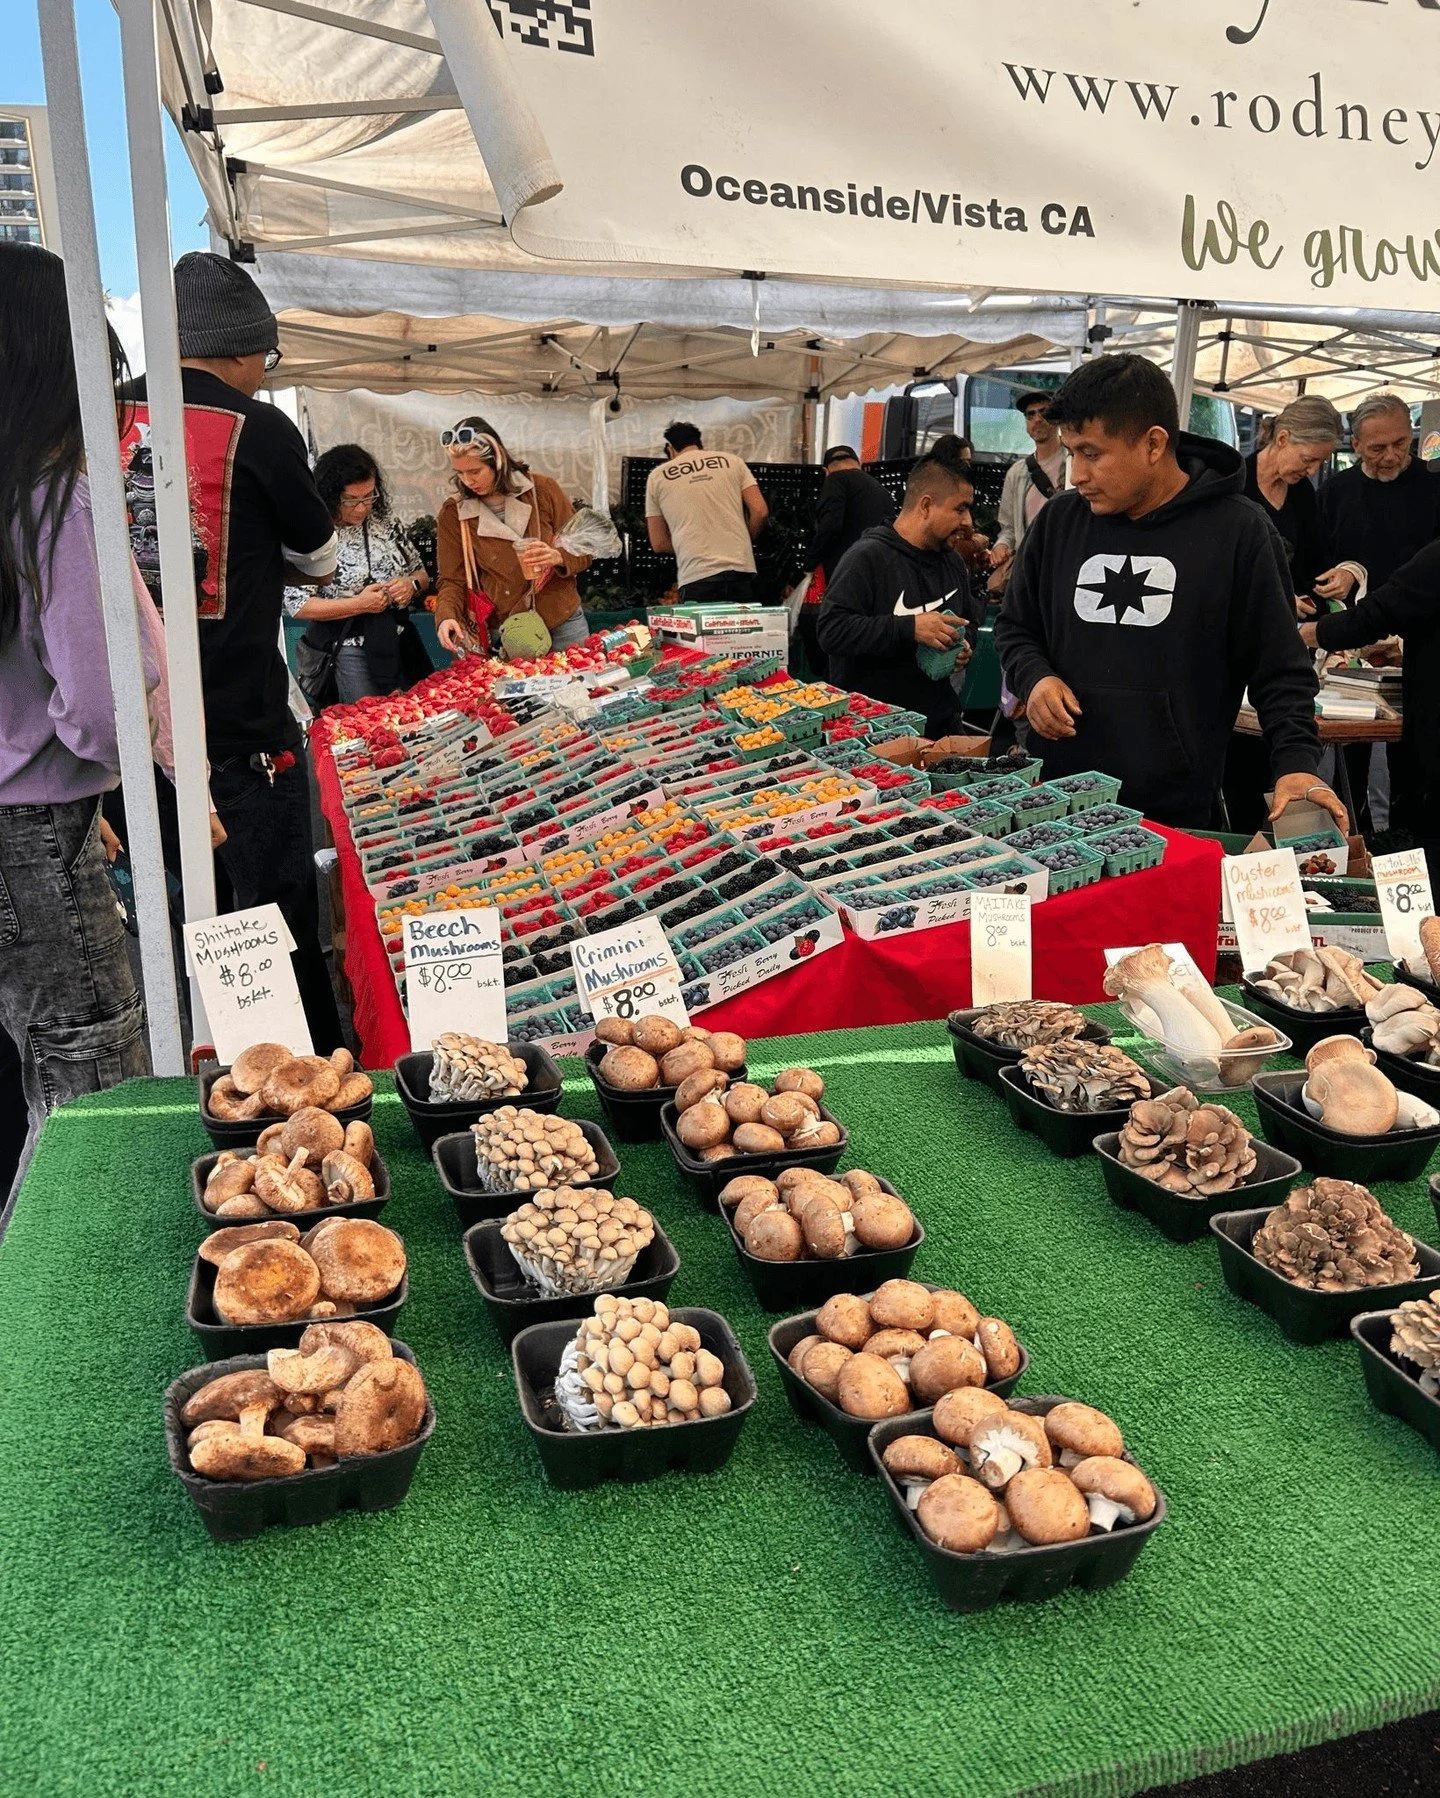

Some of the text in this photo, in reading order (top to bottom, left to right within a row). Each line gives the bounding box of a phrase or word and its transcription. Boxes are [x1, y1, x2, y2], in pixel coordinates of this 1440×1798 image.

[680, 164, 1096, 238] Oceanside/Vista CA
[1181, 194, 1284, 271] We
[1230, 862, 1280, 890] Oyster
[927, 898, 958, 914] Fresh
[928, 912, 957, 924] Picked
[975, 896, 1027, 911] MAITAKE
[194, 919, 267, 949] Shiitake
[409, 915, 481, 940] Beech
[410, 939, 500, 959] Mushrooms
[575, 930, 646, 968] Crimini
[219, 958, 273, 987] $8.00
[418, 963, 472, 993] $8.00
[584, 952, 668, 991] Mushrooms
[717, 953, 778, 985] Fresh Berry
[722, 963, 781, 995] Picked Daily
[602, 981, 656, 1019] $8.00
[551, 1041, 577, 1050] Berry
